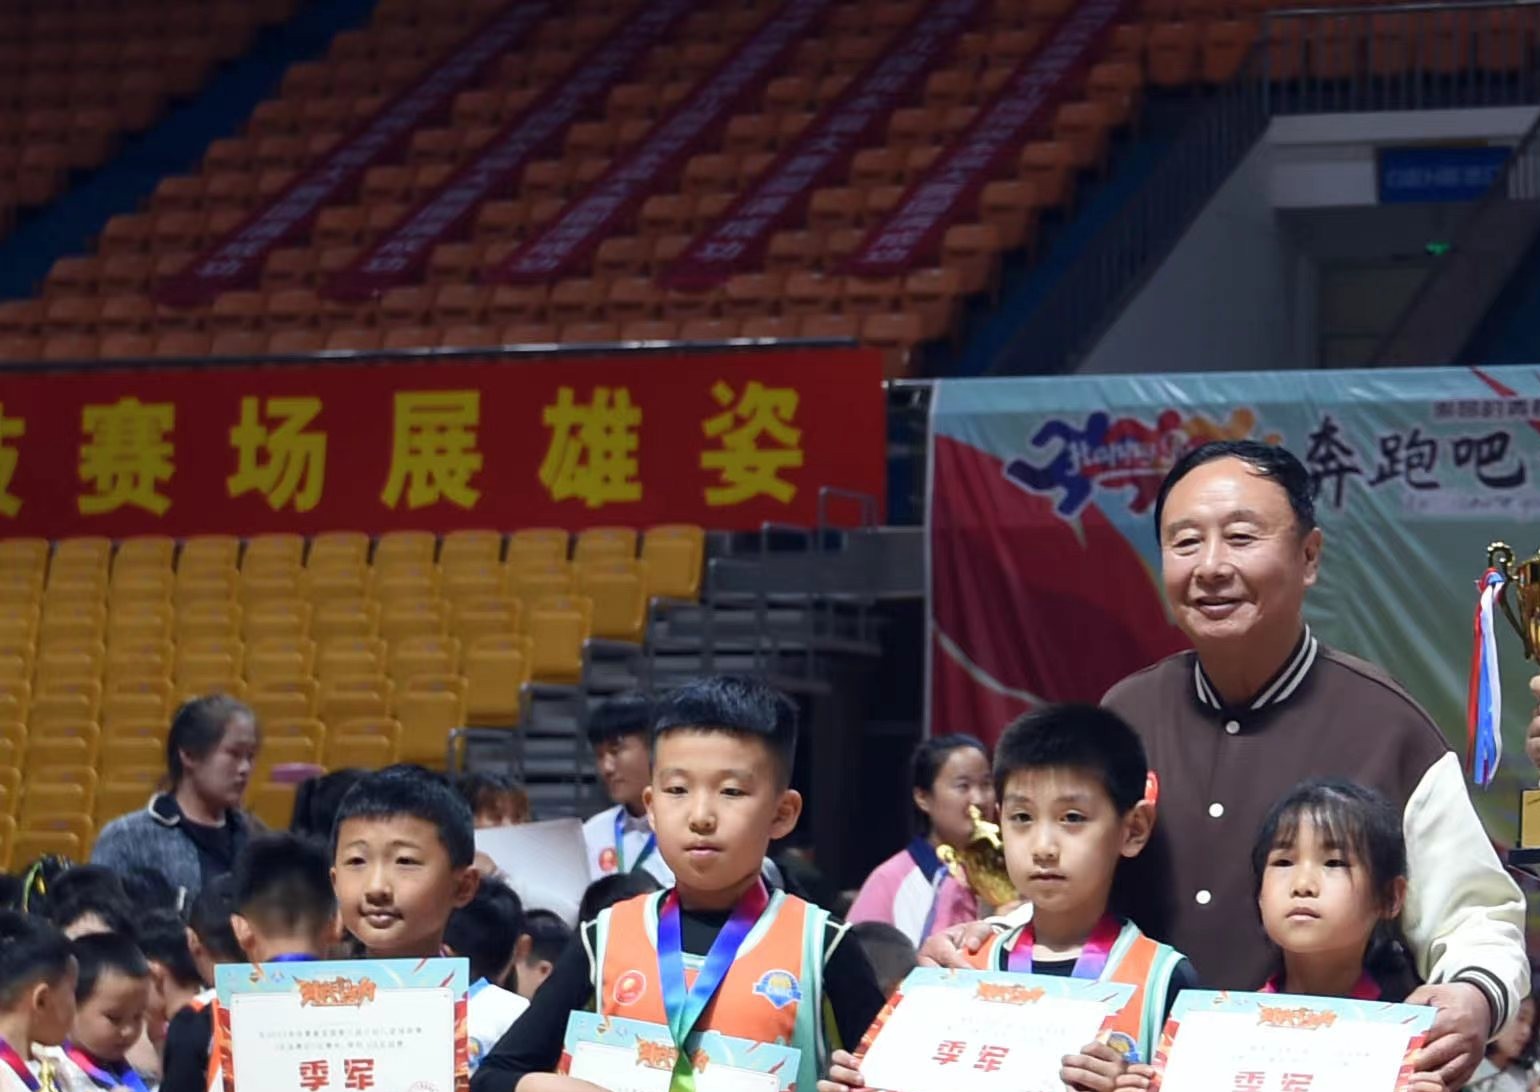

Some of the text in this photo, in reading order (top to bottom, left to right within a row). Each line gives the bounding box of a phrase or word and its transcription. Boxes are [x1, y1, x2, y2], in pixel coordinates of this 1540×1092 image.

[0, 380, 803, 517] 赛场展雄姿
[932, 1040, 1010, 1073] 季军
[300, 1058, 375, 1092] 季军
